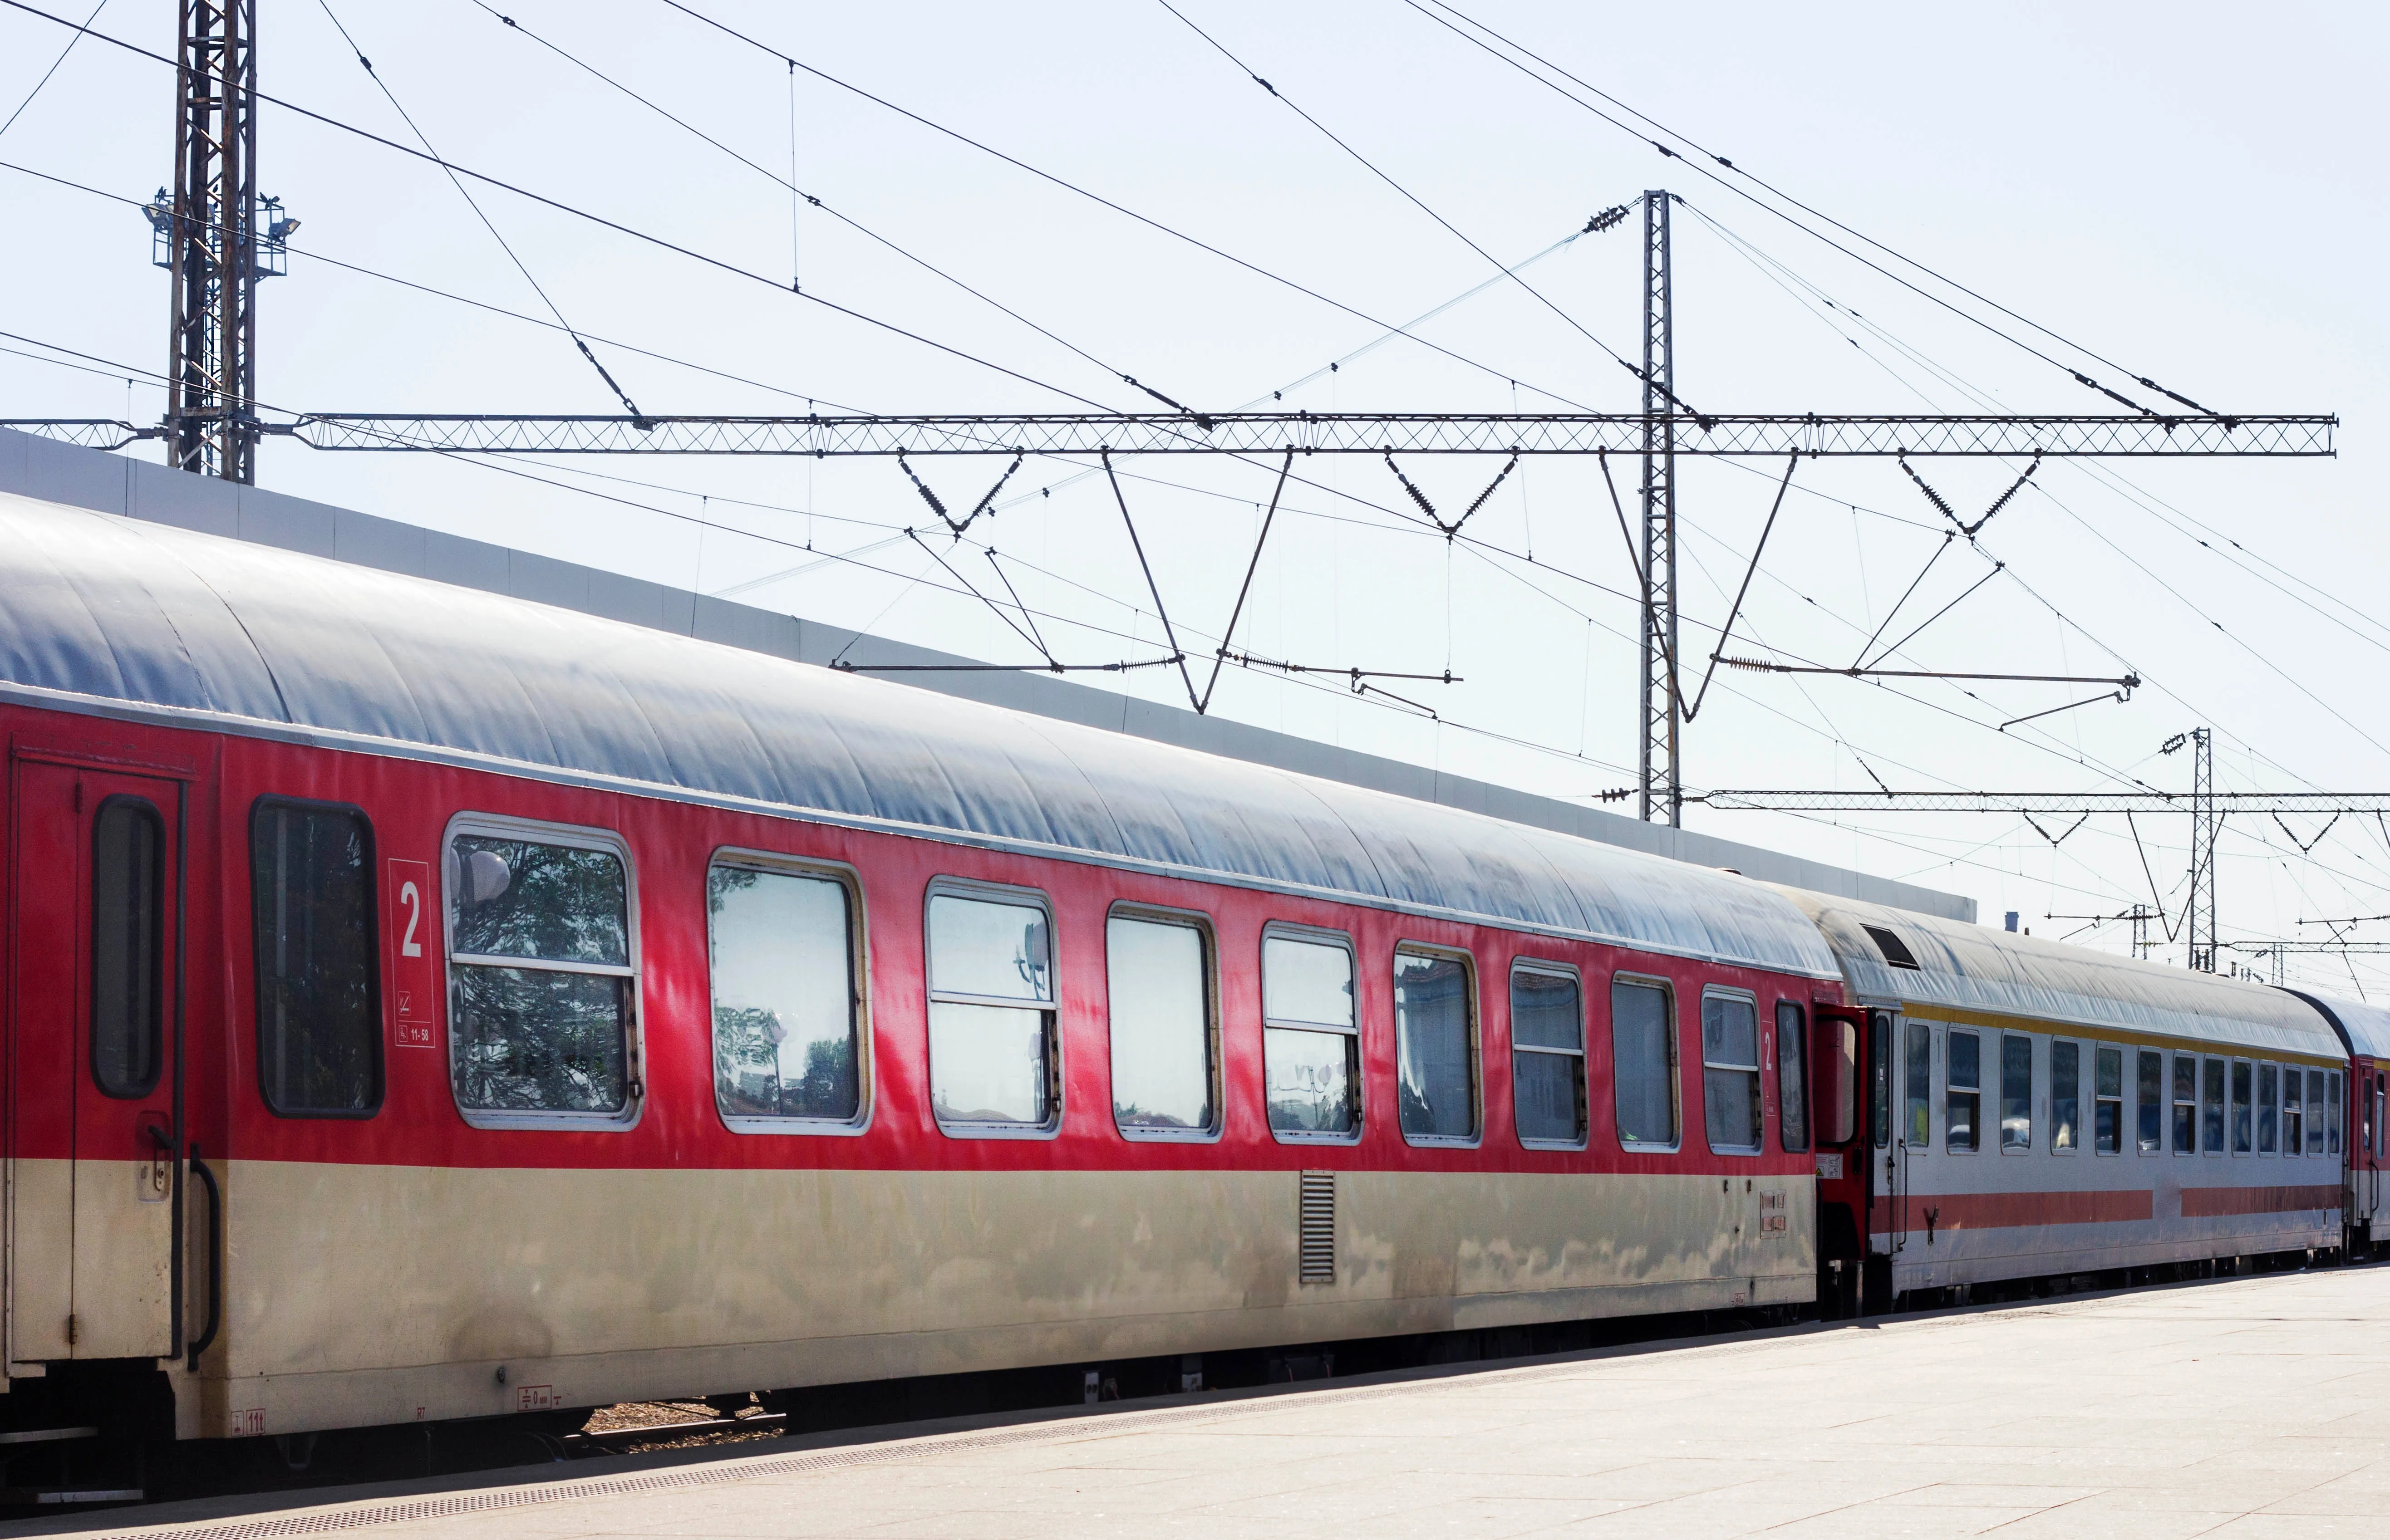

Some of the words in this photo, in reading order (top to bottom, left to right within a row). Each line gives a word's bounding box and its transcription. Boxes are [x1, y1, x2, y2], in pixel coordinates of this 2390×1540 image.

[401, 881, 421, 957] 2
[1765, 1032, 1772, 1071] 2
[249, 1412, 263, 1432] 11t
[417, 1407, 425, 1420] R7
